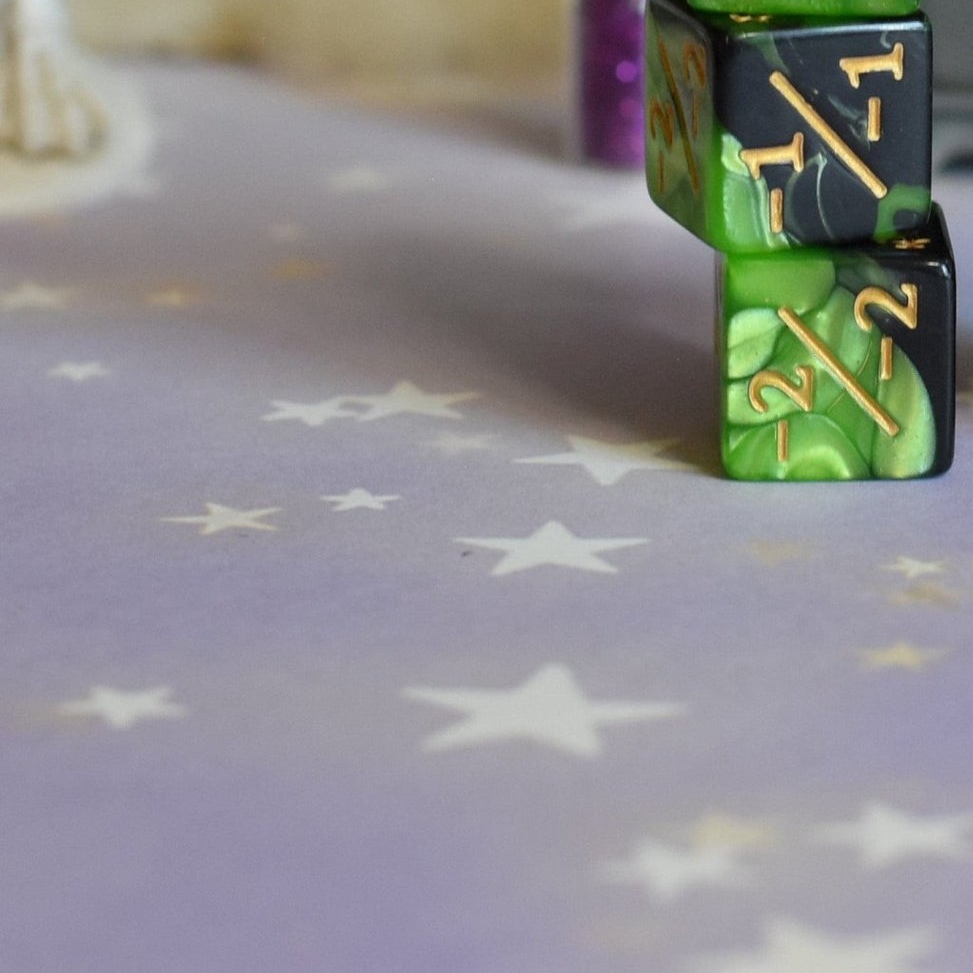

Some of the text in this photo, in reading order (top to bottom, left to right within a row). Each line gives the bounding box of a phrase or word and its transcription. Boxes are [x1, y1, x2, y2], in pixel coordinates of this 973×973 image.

[839, 42, 904, 142] -1
[739, 132, 804, 234] -1
[854, 283, 918, 380] -2
[749, 366, 814, 463] -2
